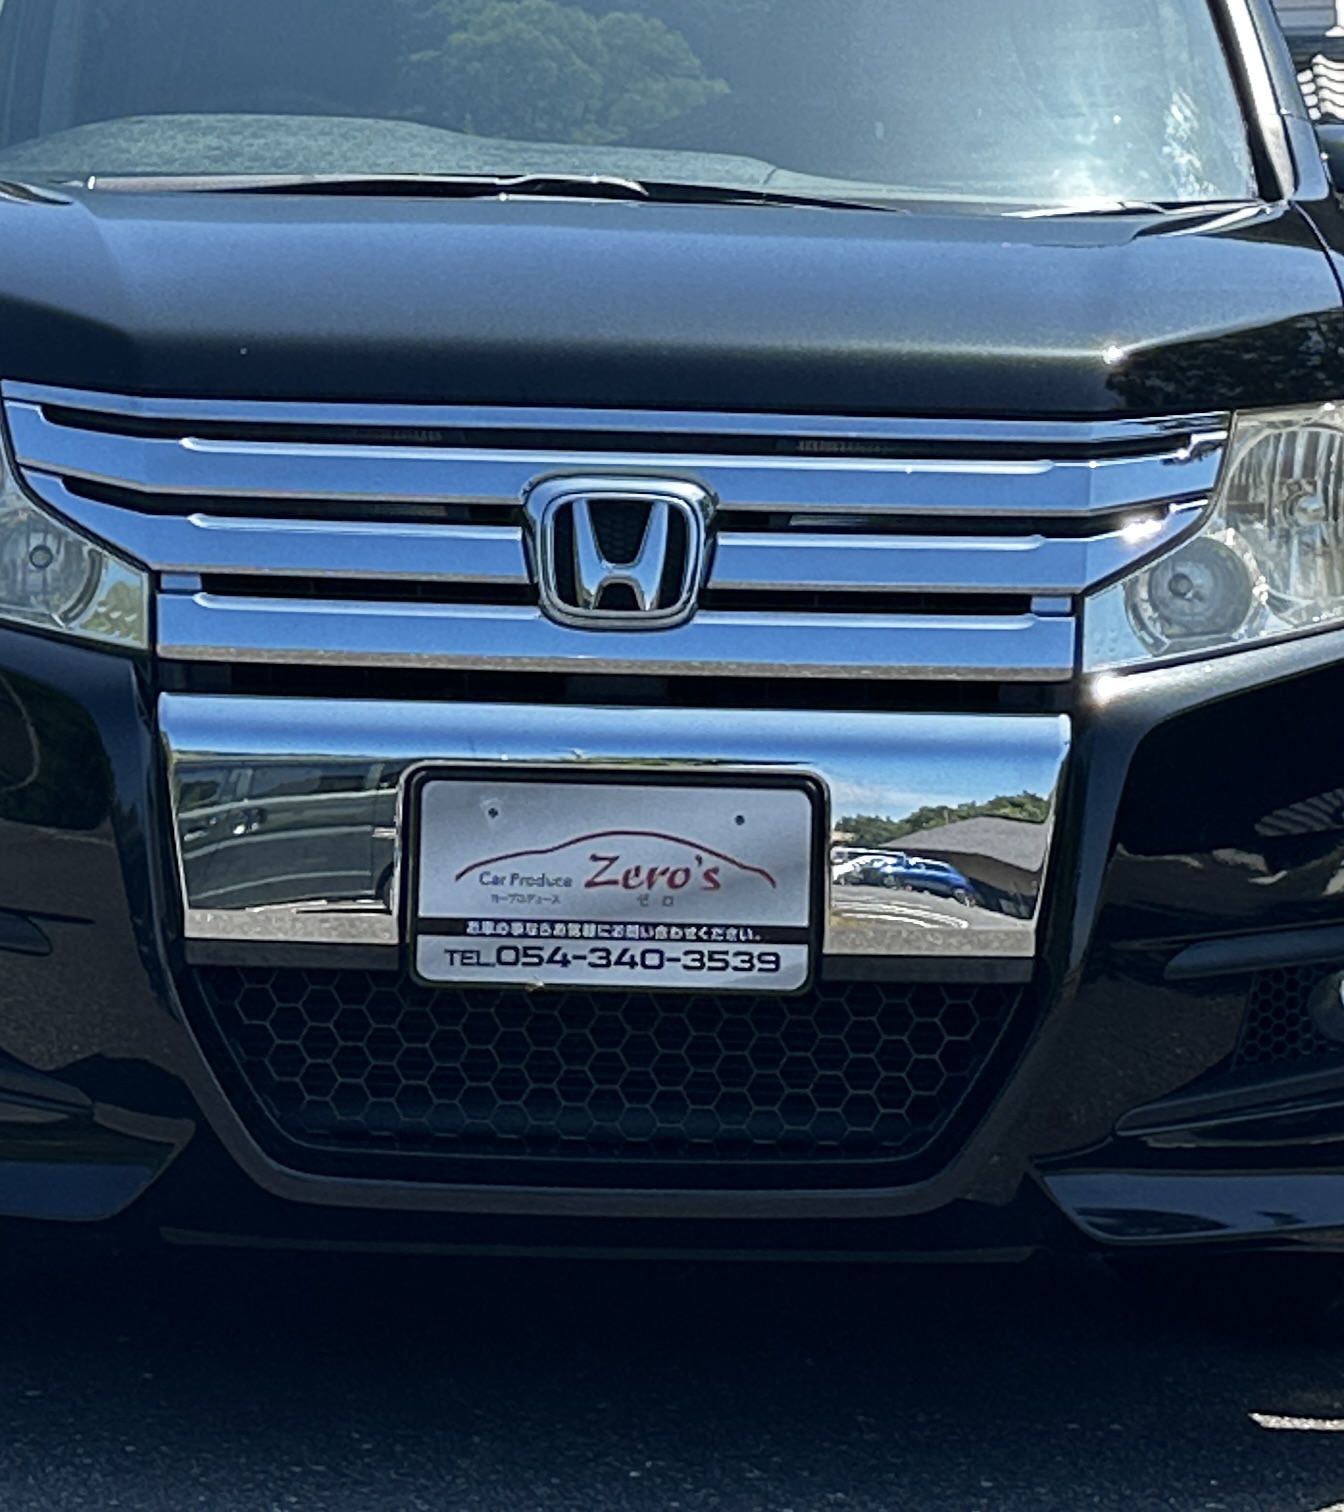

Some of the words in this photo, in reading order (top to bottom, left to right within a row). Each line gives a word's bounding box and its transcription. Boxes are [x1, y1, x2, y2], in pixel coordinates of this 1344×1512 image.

[479, 871, 507, 886] Car
[509, 872, 573, 887] Produce
[584, 854, 721, 890] Zero's
